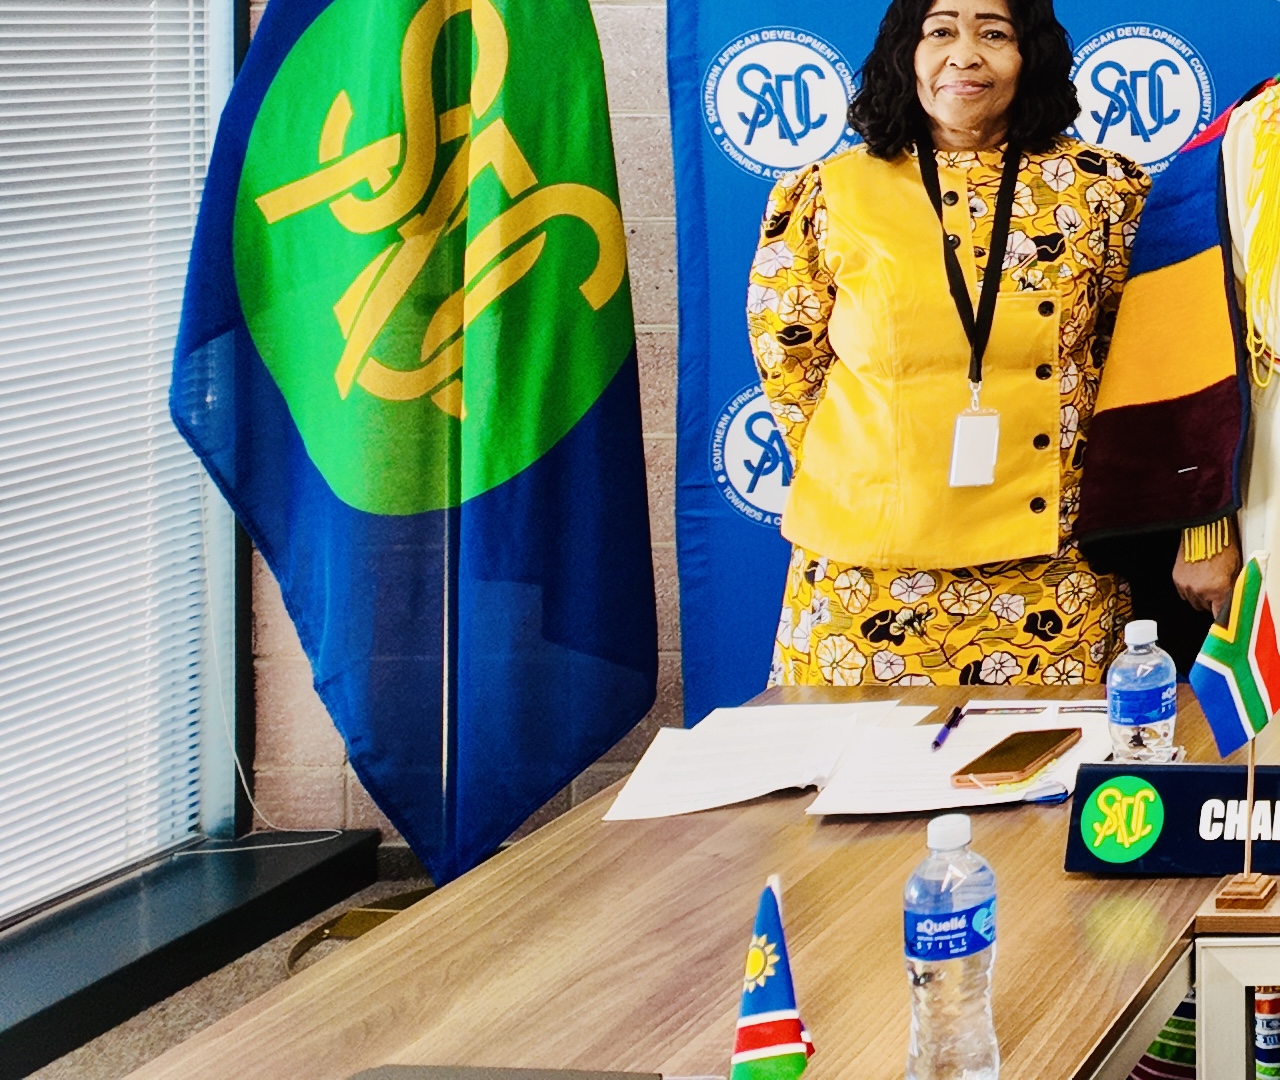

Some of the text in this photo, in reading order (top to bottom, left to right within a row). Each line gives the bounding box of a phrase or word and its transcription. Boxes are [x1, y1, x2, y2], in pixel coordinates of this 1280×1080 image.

[704, 30, 839, 123] SOUTHERN AFRICAN DEVELOPMENT
